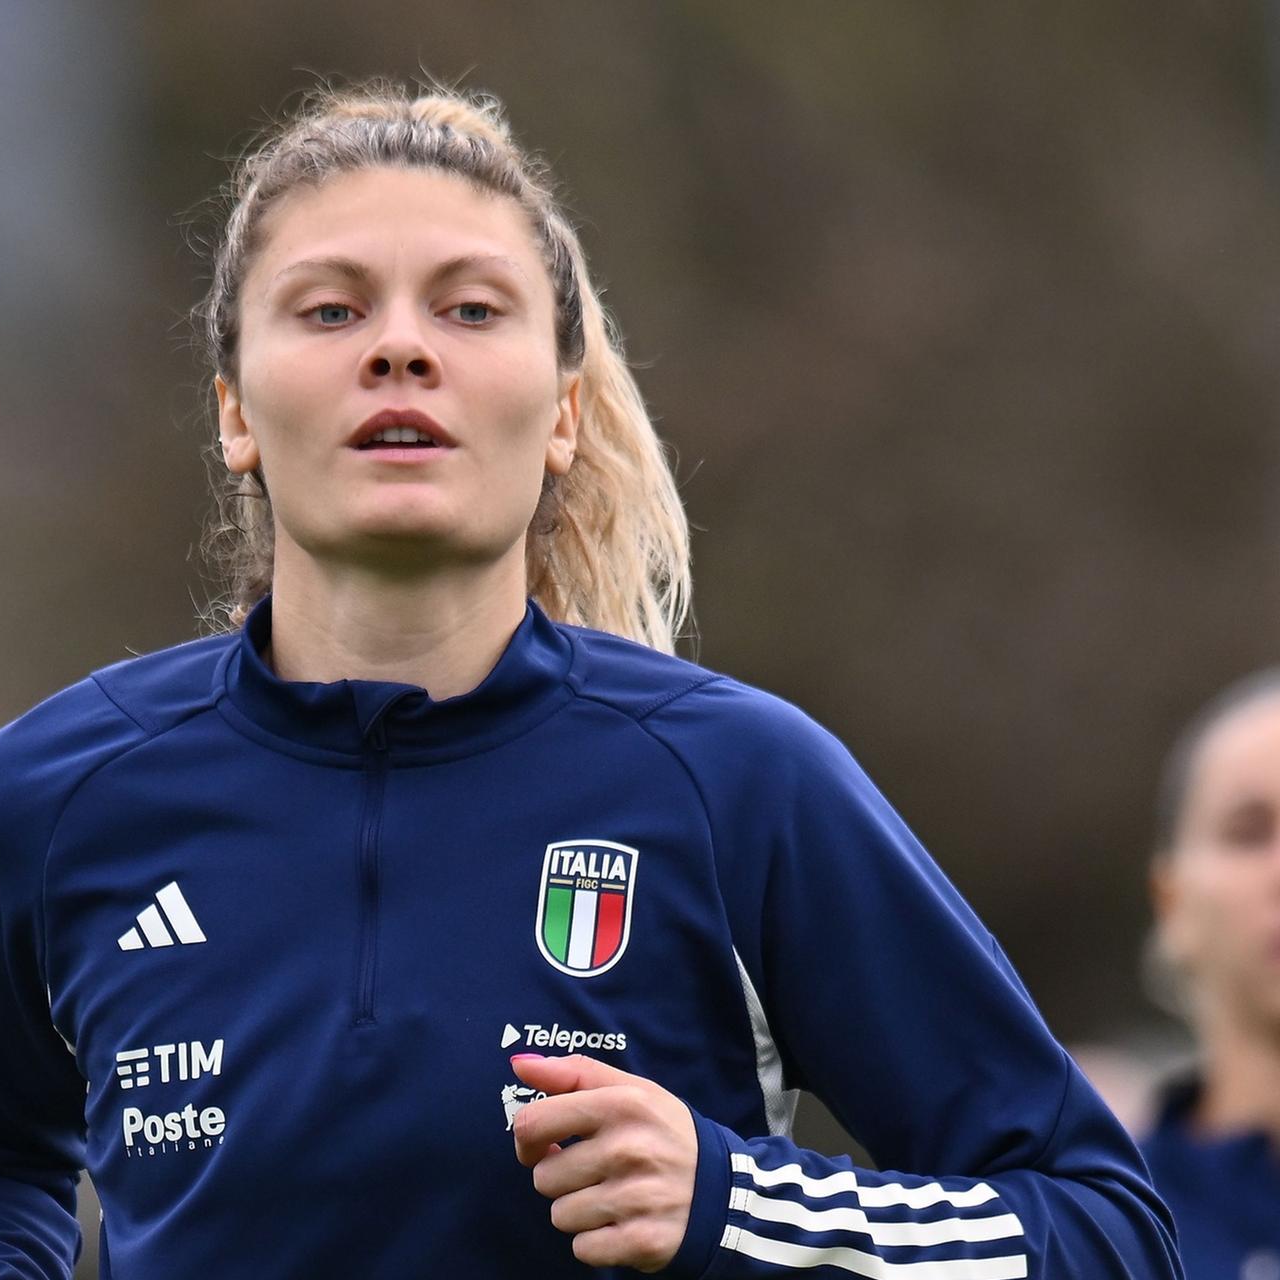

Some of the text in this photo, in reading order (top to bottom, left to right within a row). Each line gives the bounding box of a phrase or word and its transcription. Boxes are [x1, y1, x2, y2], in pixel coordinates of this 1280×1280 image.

[550, 850, 627, 881] ITALIA
[575, 878, 598, 890] FIGC
[524, 1023, 627, 1053] Telepass
[154, 1039, 224, 1083] TIM
[123, 1103, 226, 1147] Poste
